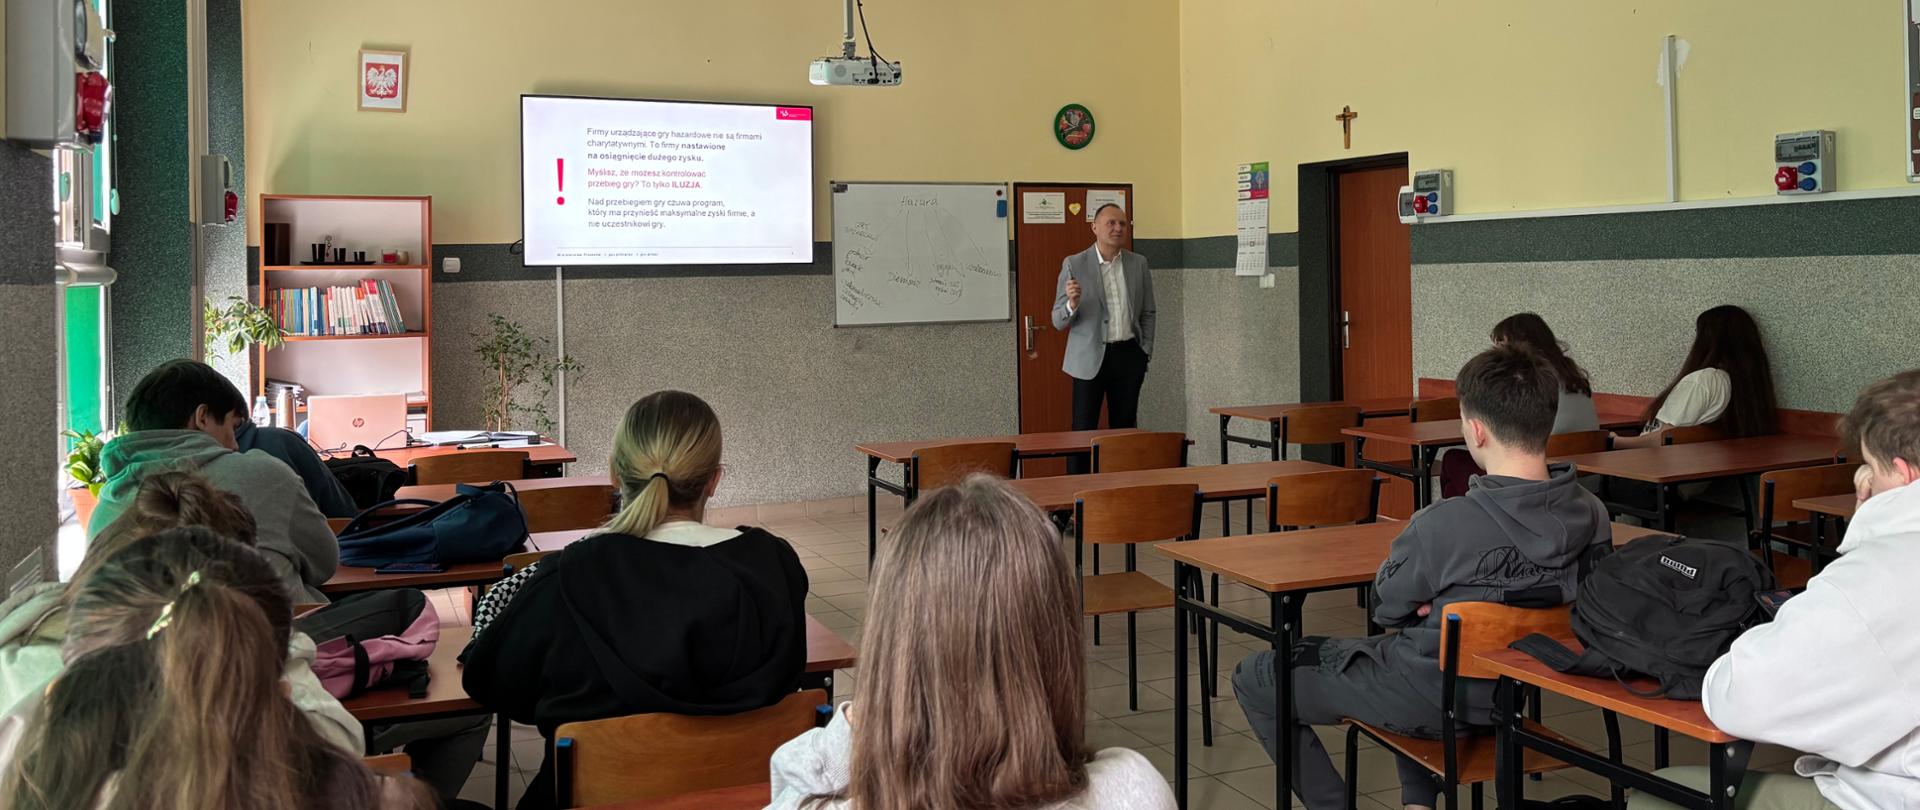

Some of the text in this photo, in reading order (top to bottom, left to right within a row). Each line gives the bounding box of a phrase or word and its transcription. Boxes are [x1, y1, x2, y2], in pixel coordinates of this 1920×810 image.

[587, 127, 608, 137] Firmy
[661, 141, 679, 150] firmy
[600, 152, 646, 161] osiągnięcie
[648, 152, 677, 162] dużego
[622, 180, 639, 189] gry?
[606, 199, 652, 207] przebiegiem
[588, 209, 607, 217] który
[623, 209, 658, 217] przynieść
[660, 210, 706, 218] maksymalne
